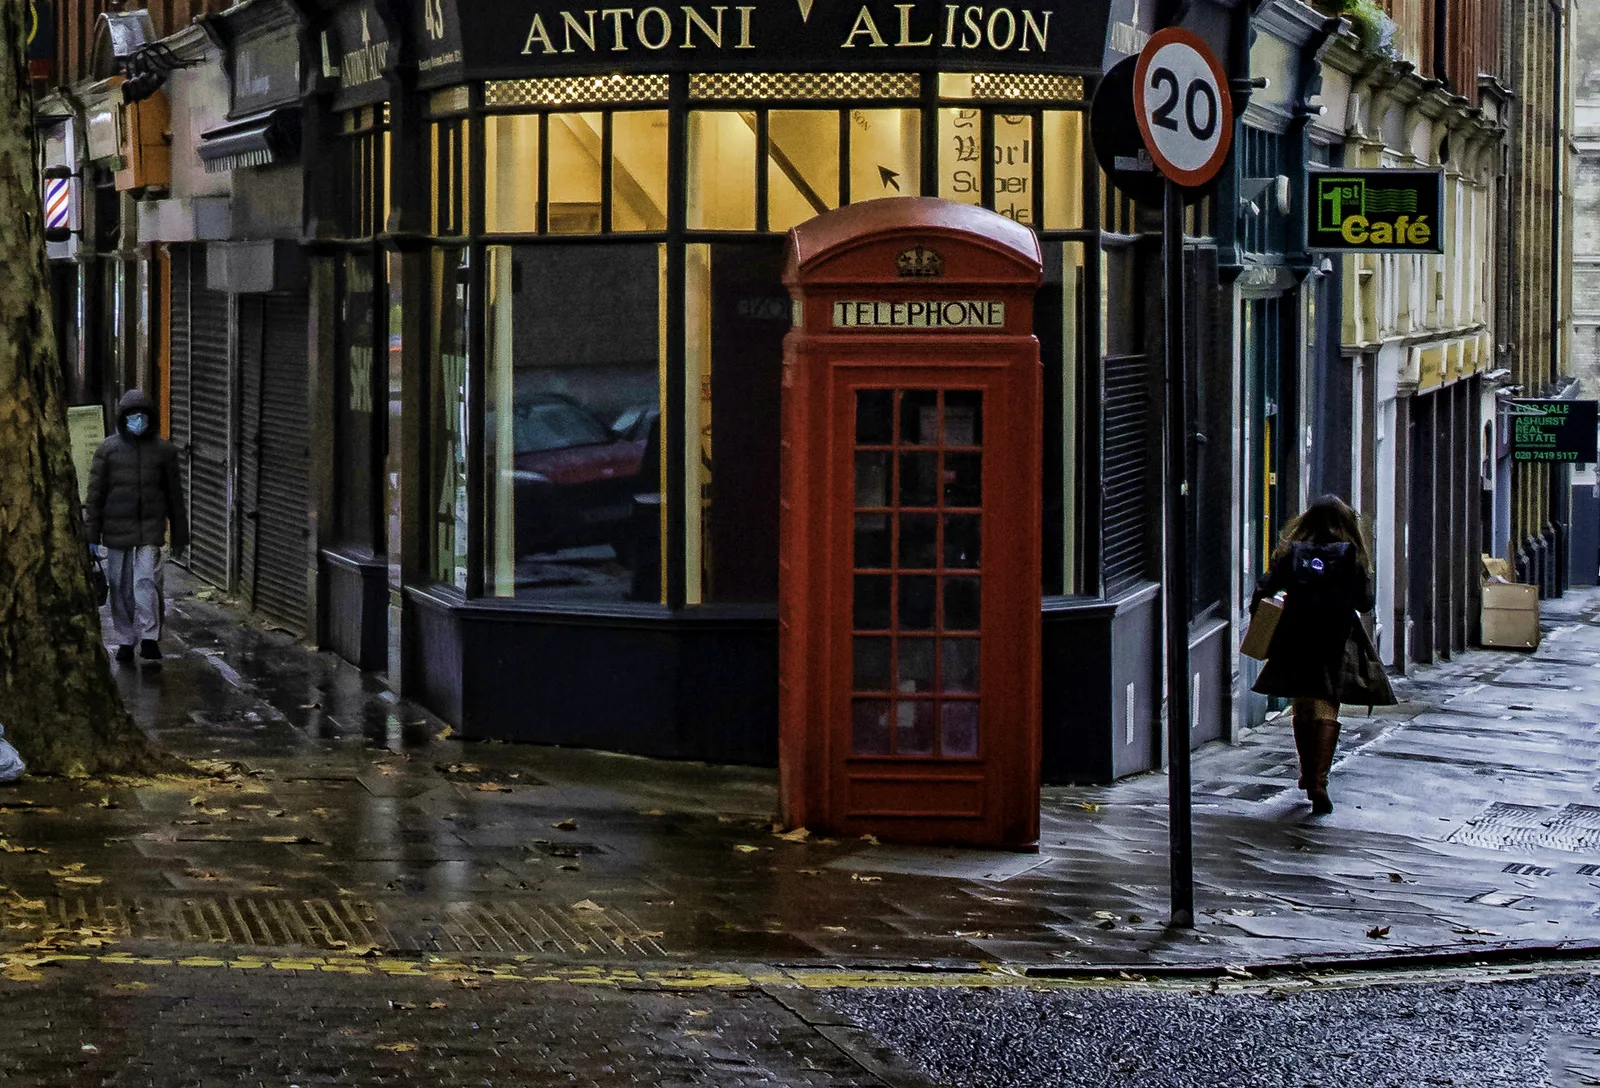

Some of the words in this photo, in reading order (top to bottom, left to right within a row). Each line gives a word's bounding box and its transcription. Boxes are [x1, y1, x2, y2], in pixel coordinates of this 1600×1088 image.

[521, 6, 758, 55] ANTONI
[840, 4, 1054, 52] ALISON
[1151, 67, 1217, 141] 20
[1323, 185, 1360, 226] 1st
[1342, 215, 1431, 244] Café
[836, 302, 1004, 326] TELEPHONE
[1542, 404, 1569, 414] SALE
[1515, 416, 1566, 426] ASHURST
[1515, 425, 1542, 434] REAL
[1515, 433, 1556, 443] ESTATE
[1514, 451, 1531, 460] 020
[1533, 451, 1554, 460] 7419
[1556, 451, 1578, 460] 5117
